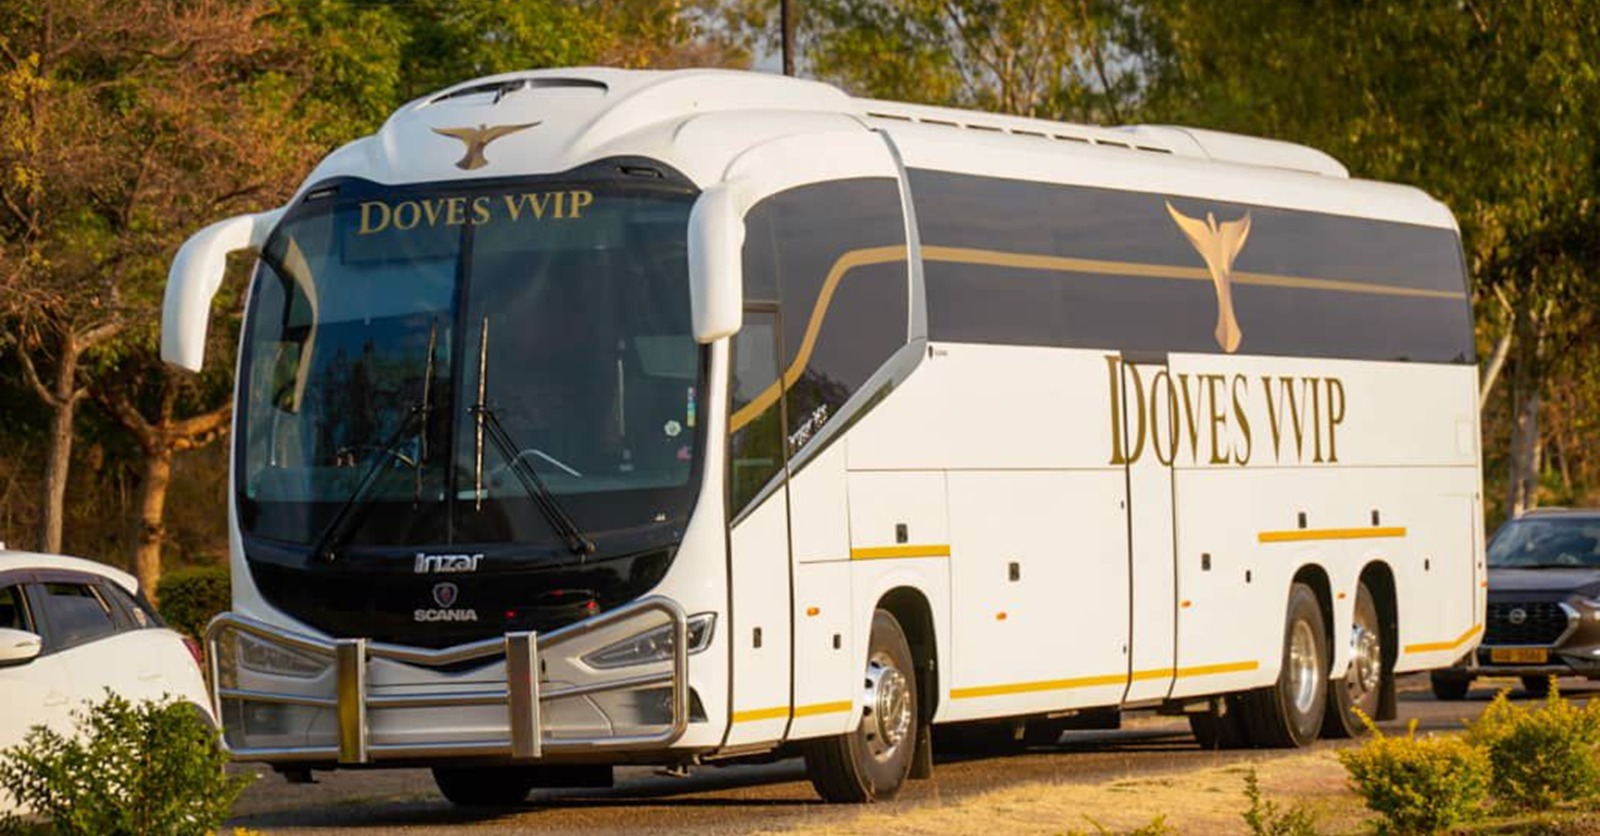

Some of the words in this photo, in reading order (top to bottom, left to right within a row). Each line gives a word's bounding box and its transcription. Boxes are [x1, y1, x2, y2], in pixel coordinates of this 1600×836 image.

[359, 197, 491, 235] DOVES
[503, 190, 593, 221] VVIP
[1104, 354, 1251, 466] DOVES
[1261, 375, 1345, 463] VVIP
[414, 608, 478, 621] SCANIA
